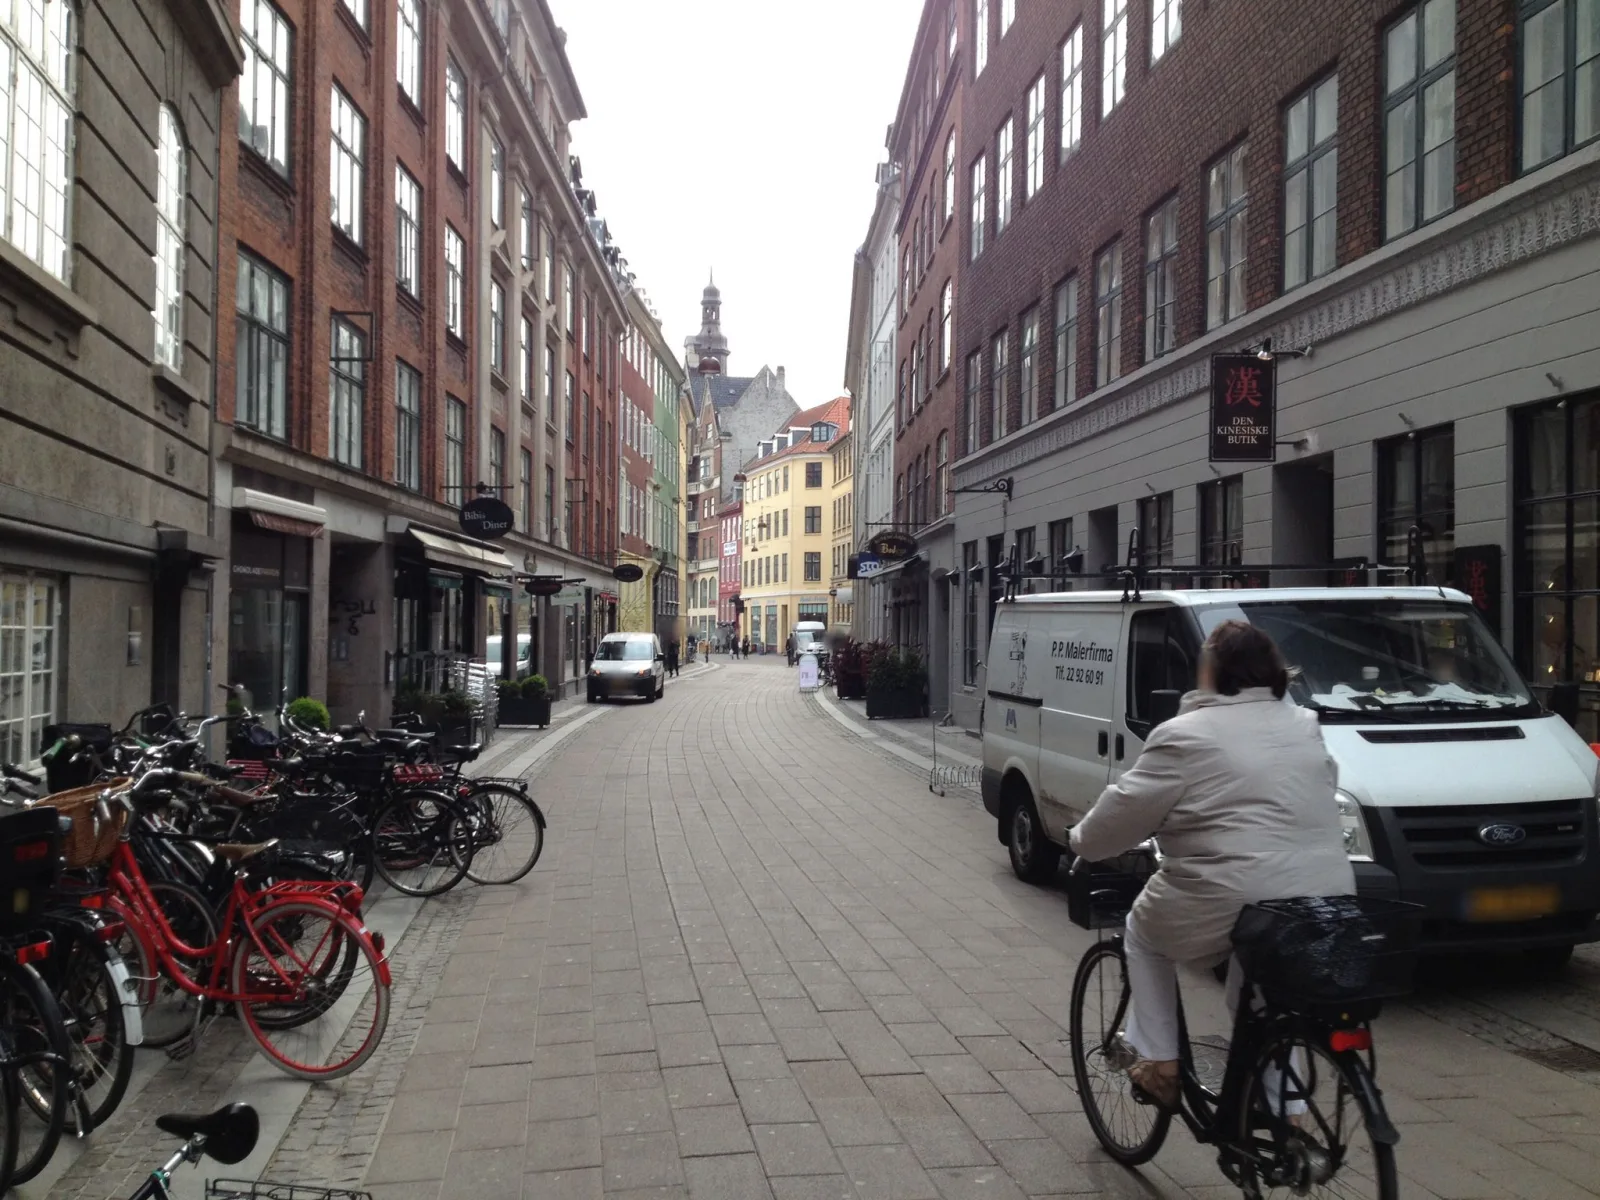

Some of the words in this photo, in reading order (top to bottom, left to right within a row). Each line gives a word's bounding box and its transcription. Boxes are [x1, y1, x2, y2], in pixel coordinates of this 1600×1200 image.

[1225, 366, 1262, 407] 漢
[1232, 417, 1254, 425] DEN
[1217, 426, 1269, 435] KINESISKE
[1228, 436, 1258, 444] BUTIK
[482, 521, 507, 530] Diner
[1065, 641, 1113, 662] Malerfirma
[1066, 667, 1074, 682] 22
[1075, 668, 1084, 683] 92
[1085, 669, 1094, 684] 60
[1095, 670, 1104, 686] 91
[1492, 828, 1517, 841] Ford
